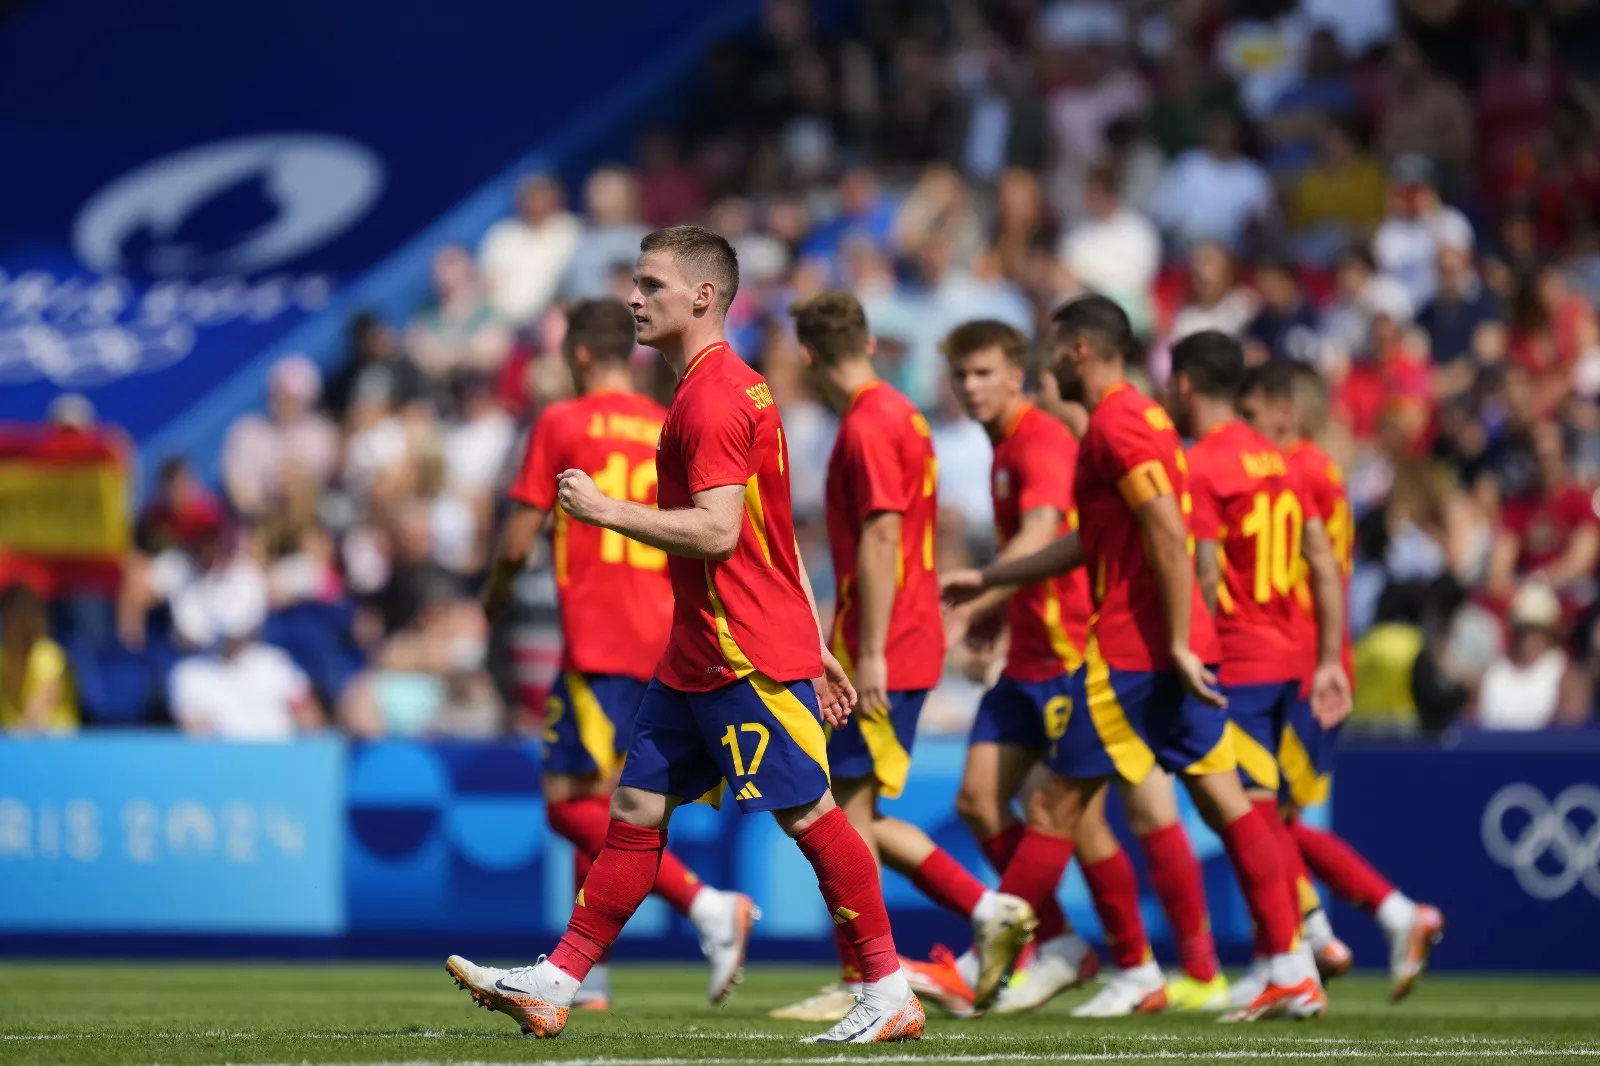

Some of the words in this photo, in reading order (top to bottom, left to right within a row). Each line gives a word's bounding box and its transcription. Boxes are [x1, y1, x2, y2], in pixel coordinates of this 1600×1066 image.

[1241, 488, 1303, 604] 10
[721, 722, 770, 776] 17
[120, 798, 308, 863] 2024
